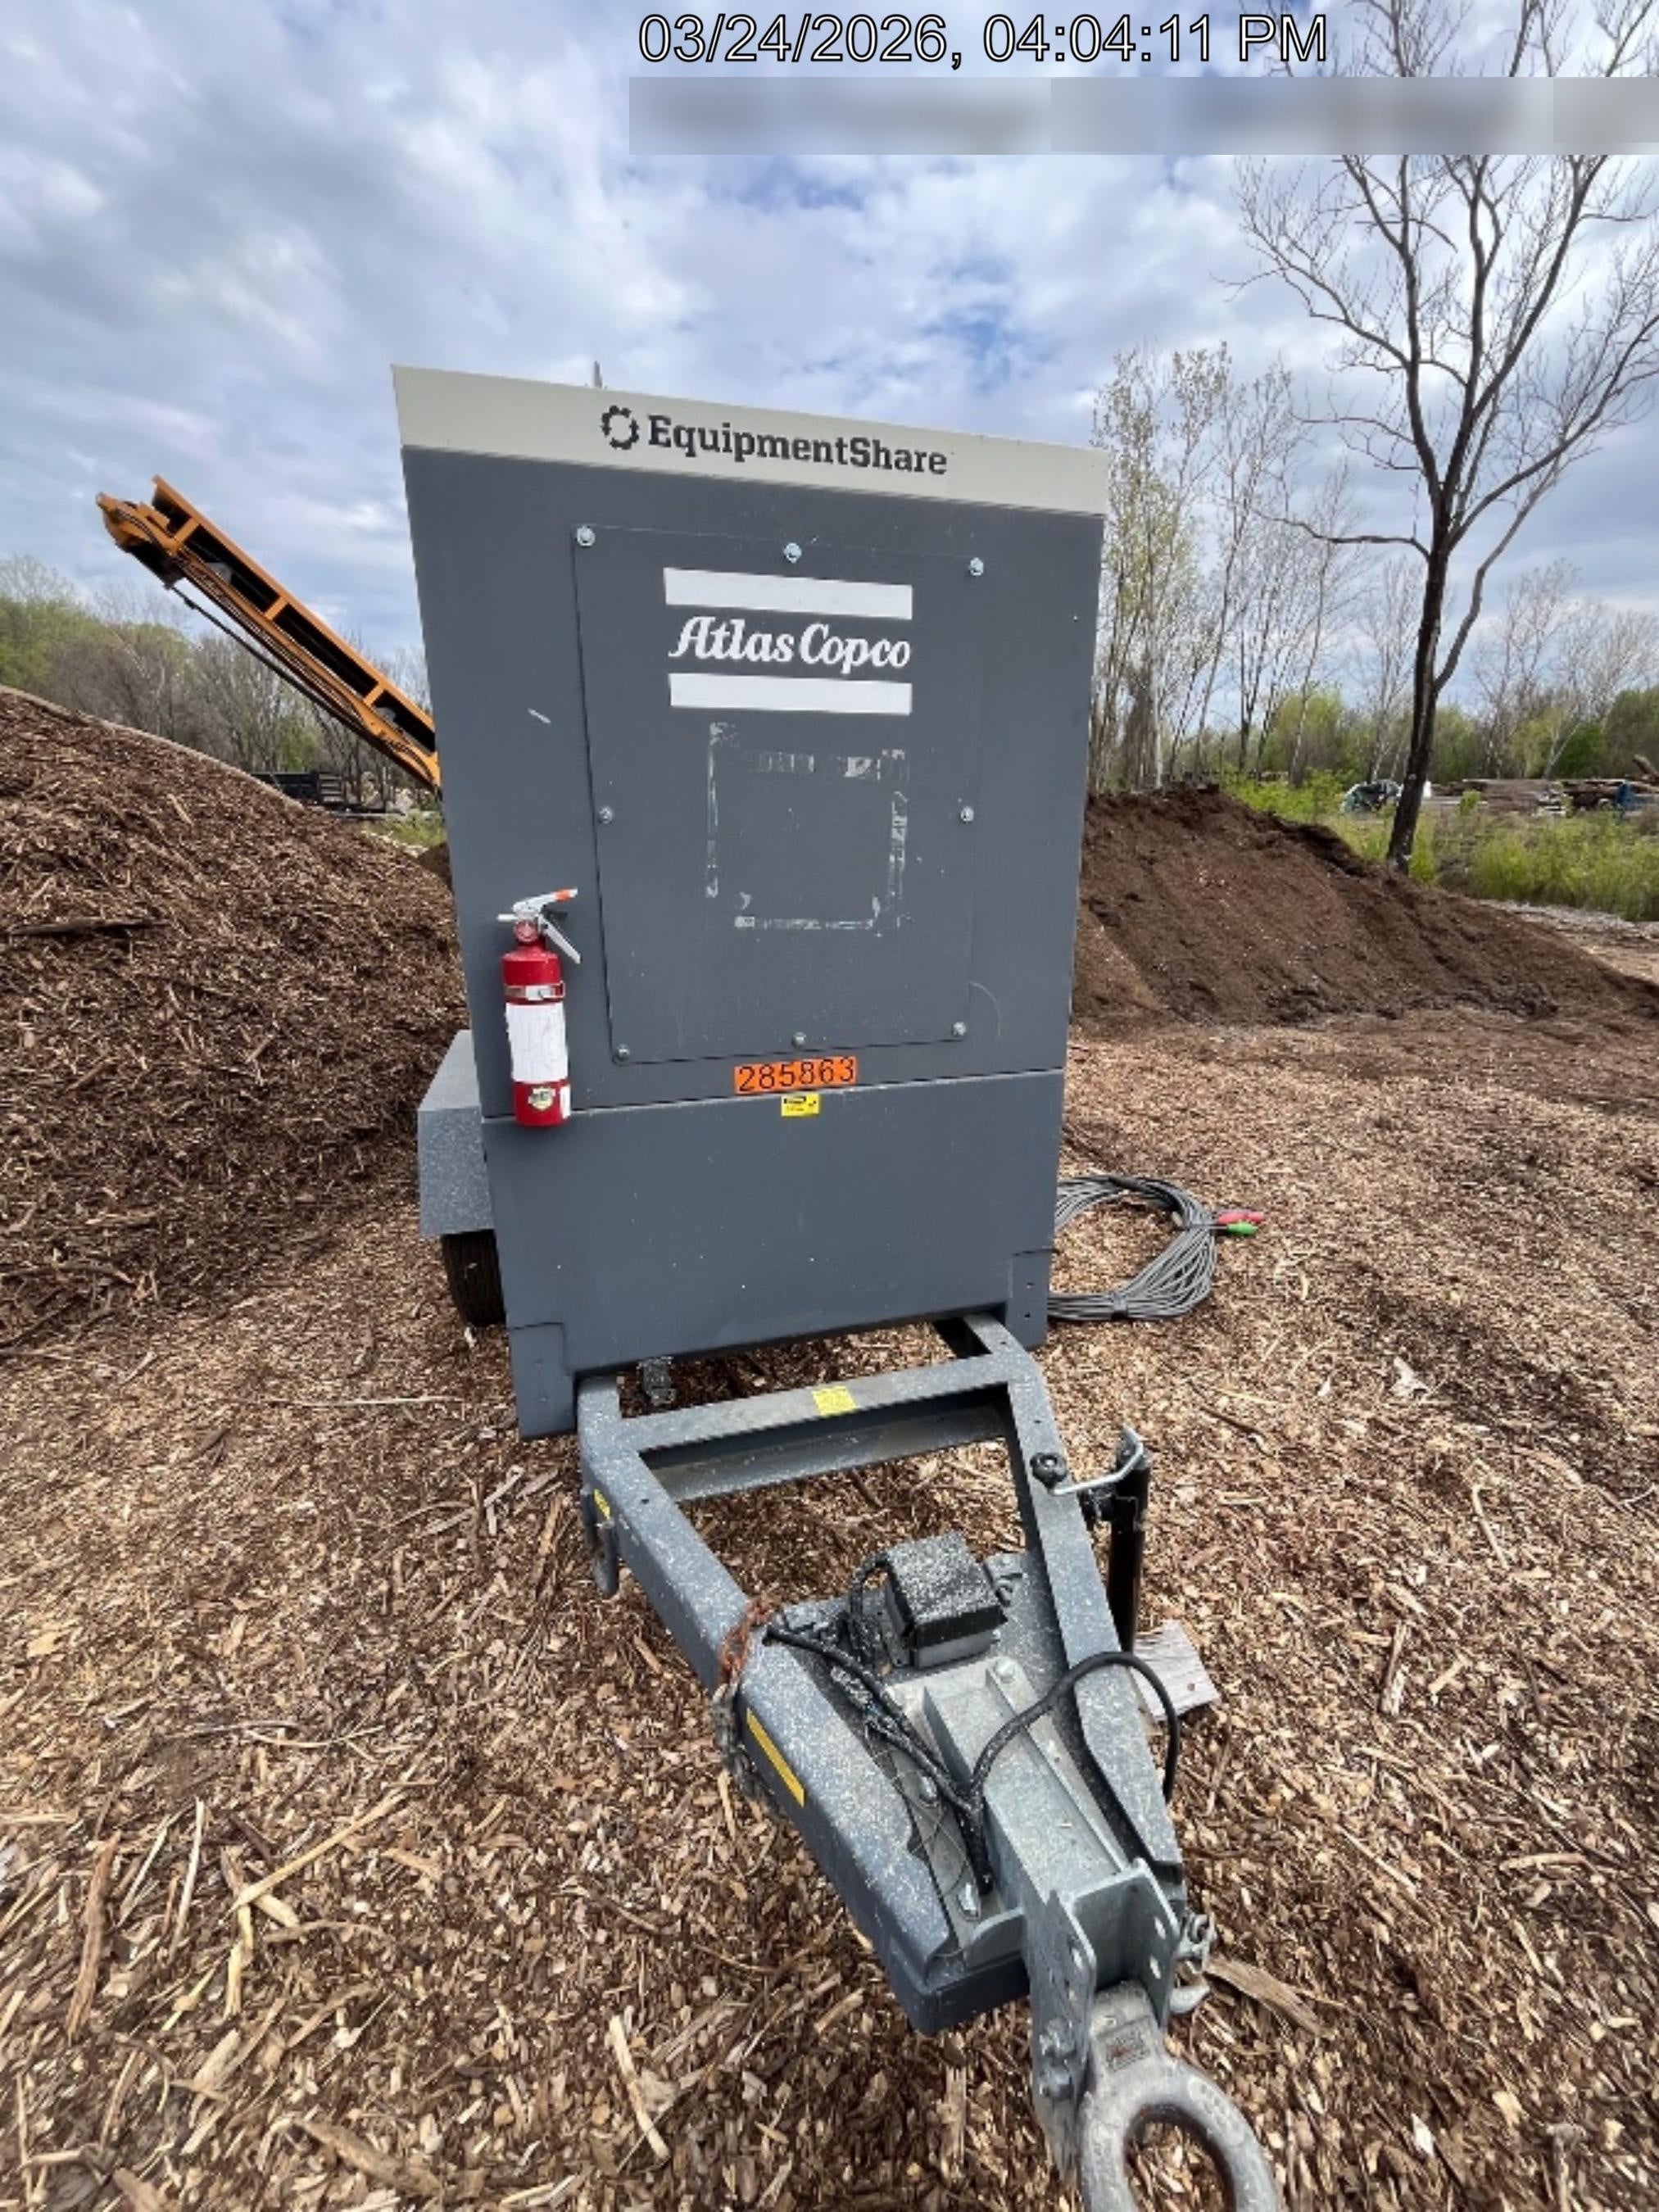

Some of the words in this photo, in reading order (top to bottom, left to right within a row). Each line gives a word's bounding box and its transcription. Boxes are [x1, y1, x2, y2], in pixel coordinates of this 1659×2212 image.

[647, 414, 948, 474] EquipmentShare
[668, 616, 796, 663] Atlas
[800, 623, 911, 674] Copco
[738, 1057, 854, 1092] 285863
